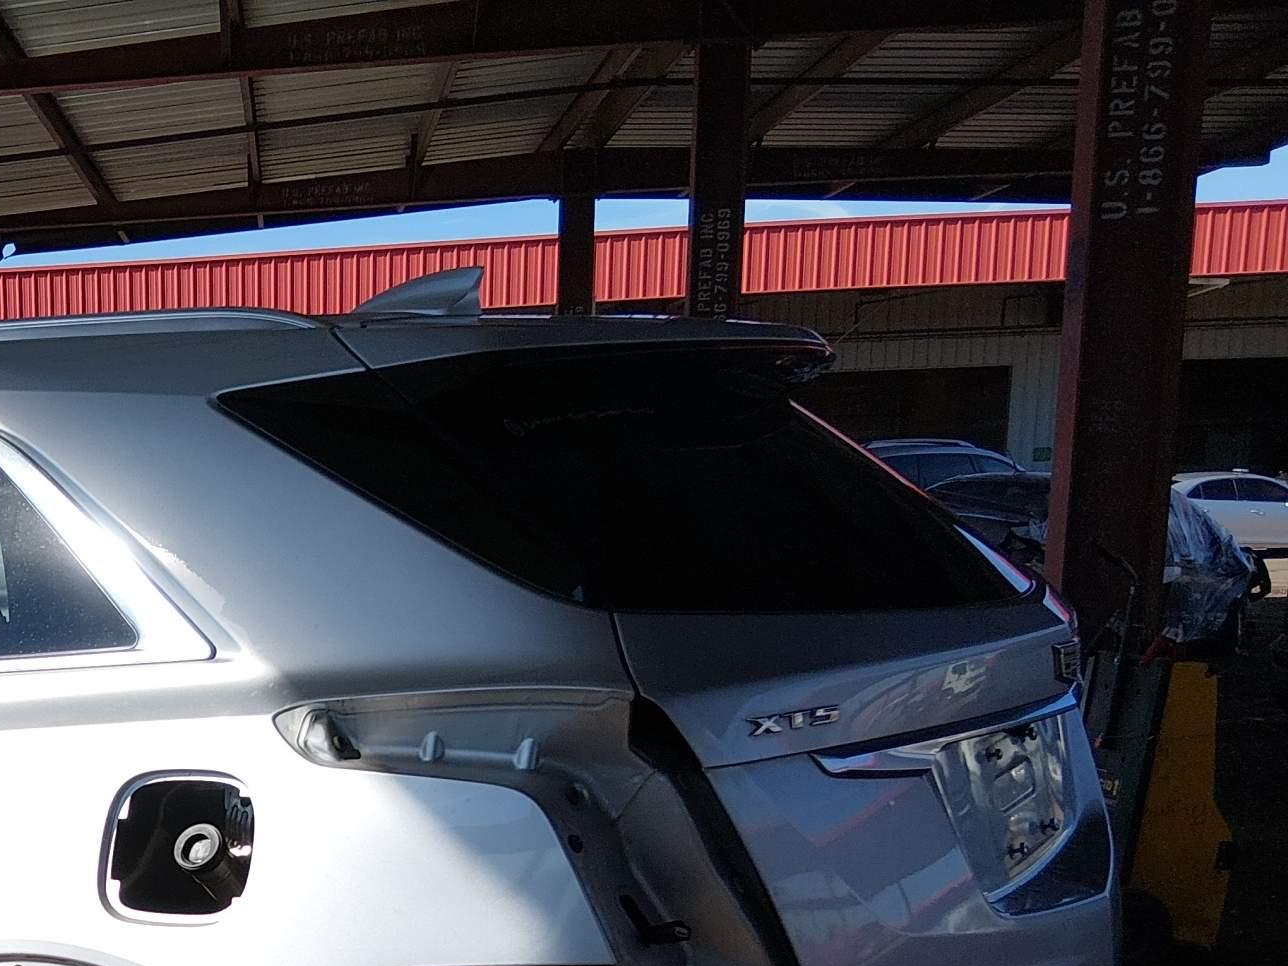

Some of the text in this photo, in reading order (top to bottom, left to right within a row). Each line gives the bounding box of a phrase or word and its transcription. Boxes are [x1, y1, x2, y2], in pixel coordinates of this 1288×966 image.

[1106, 7, 1143, 138] PREFAB
[696, 248, 713, 312] PREFAB
[744, 704, 841, 737] XT5
